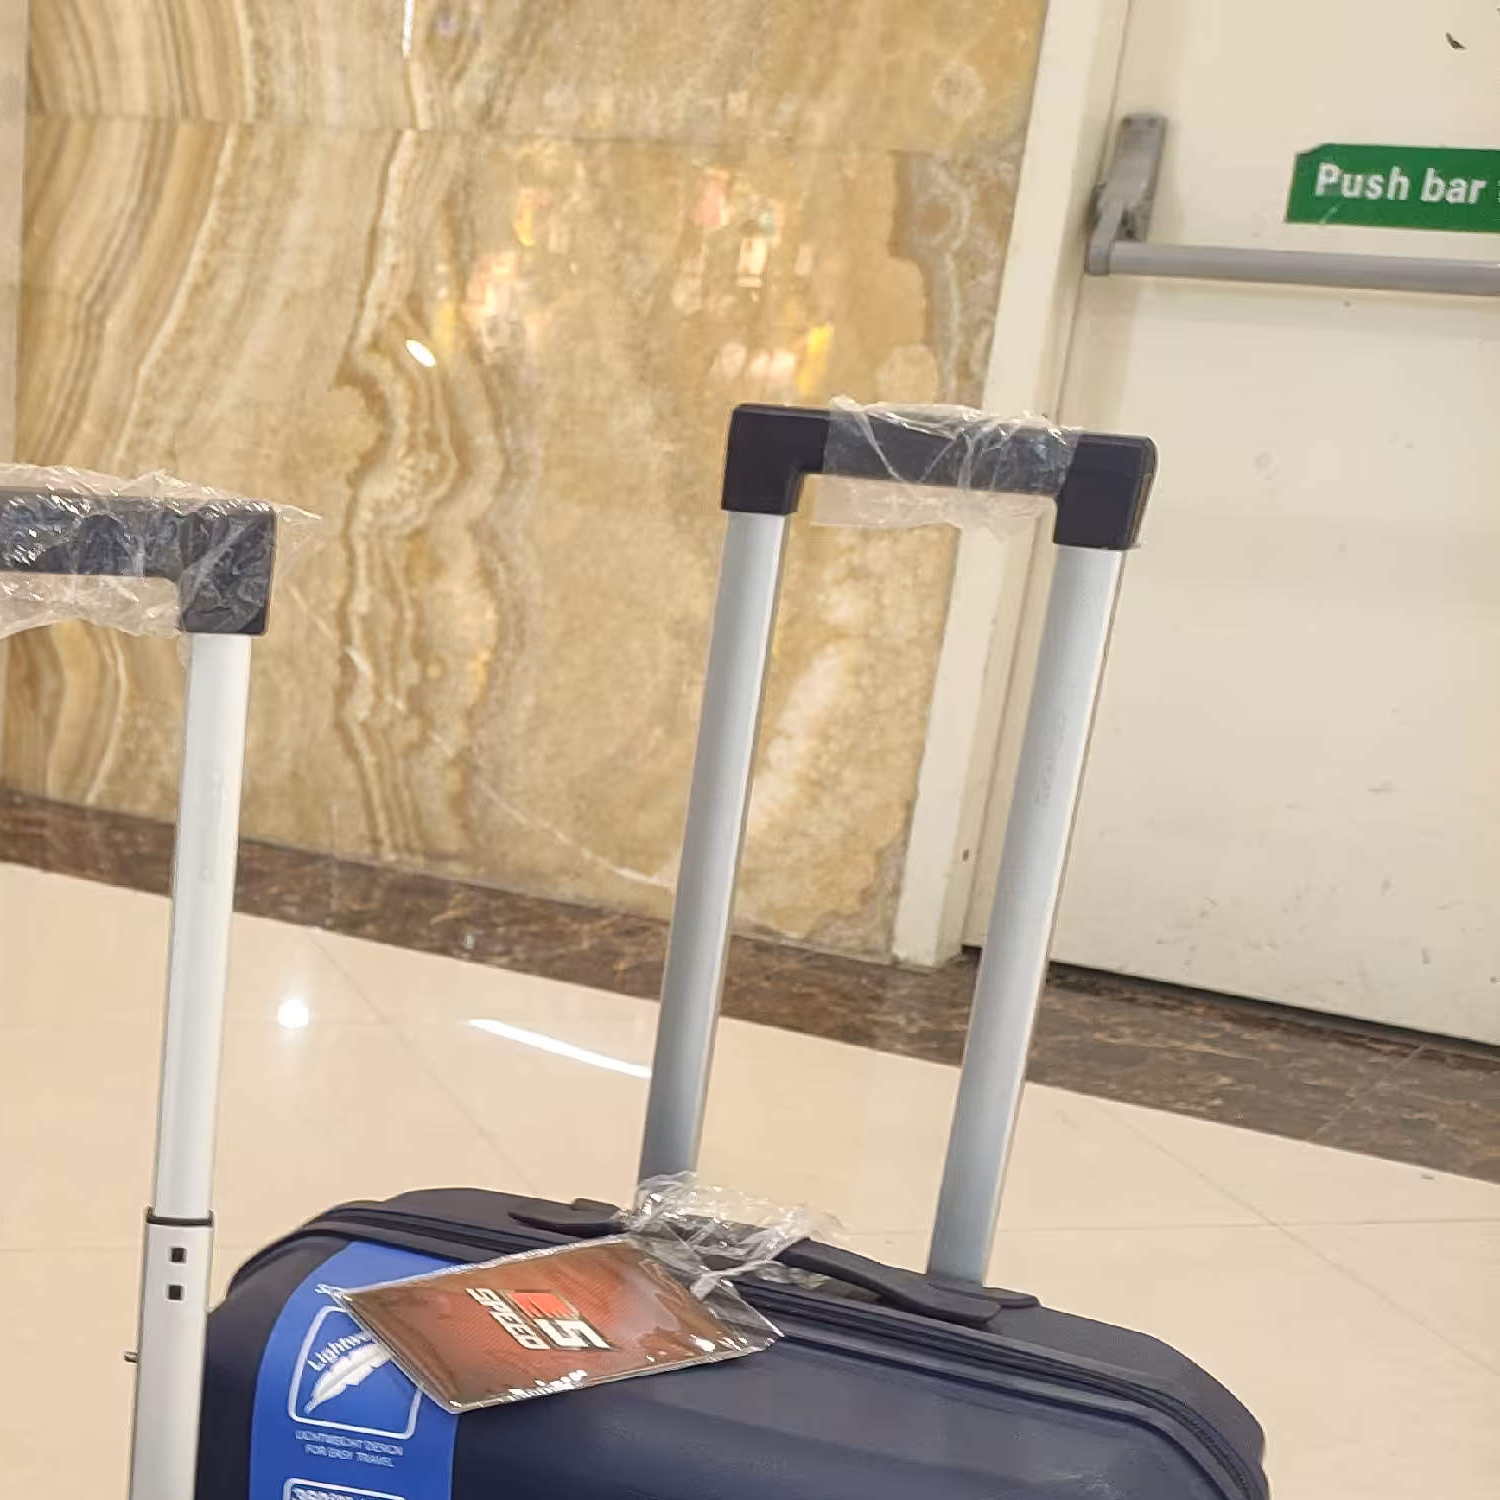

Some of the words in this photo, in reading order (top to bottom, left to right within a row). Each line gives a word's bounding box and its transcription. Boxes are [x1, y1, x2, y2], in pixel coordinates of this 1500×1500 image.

[1315, 162, 1410, 201] Push
[1421, 167, 1487, 204] bar
[465, 1287, 551, 1351] SPEED
